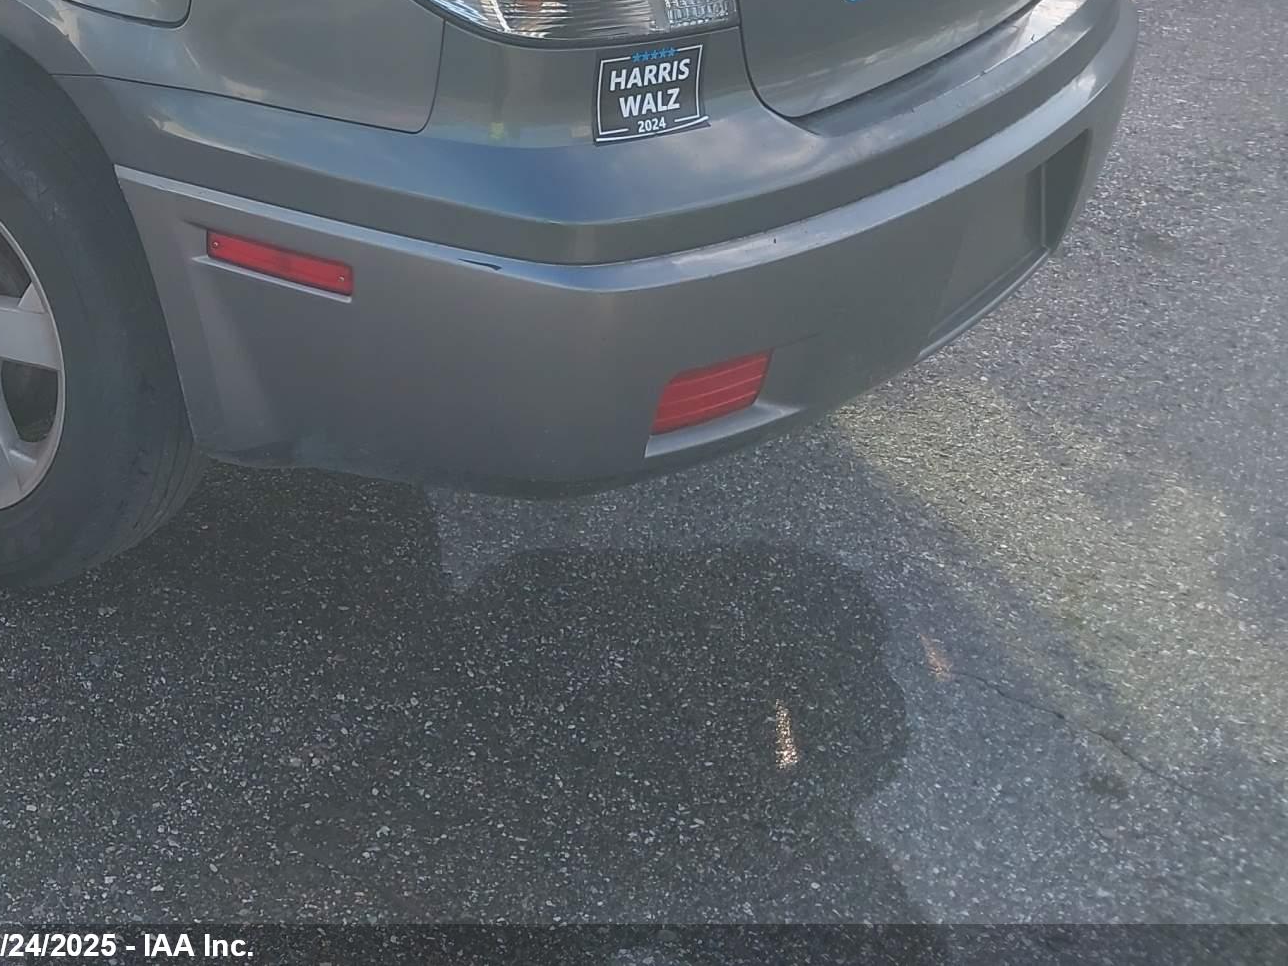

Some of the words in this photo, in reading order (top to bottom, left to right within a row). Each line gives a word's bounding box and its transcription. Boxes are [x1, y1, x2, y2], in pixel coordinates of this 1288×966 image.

[609, 58, 691, 92] HARRIS
[618, 87, 681, 118] WALZ
[637, 116, 667, 133] 2024
